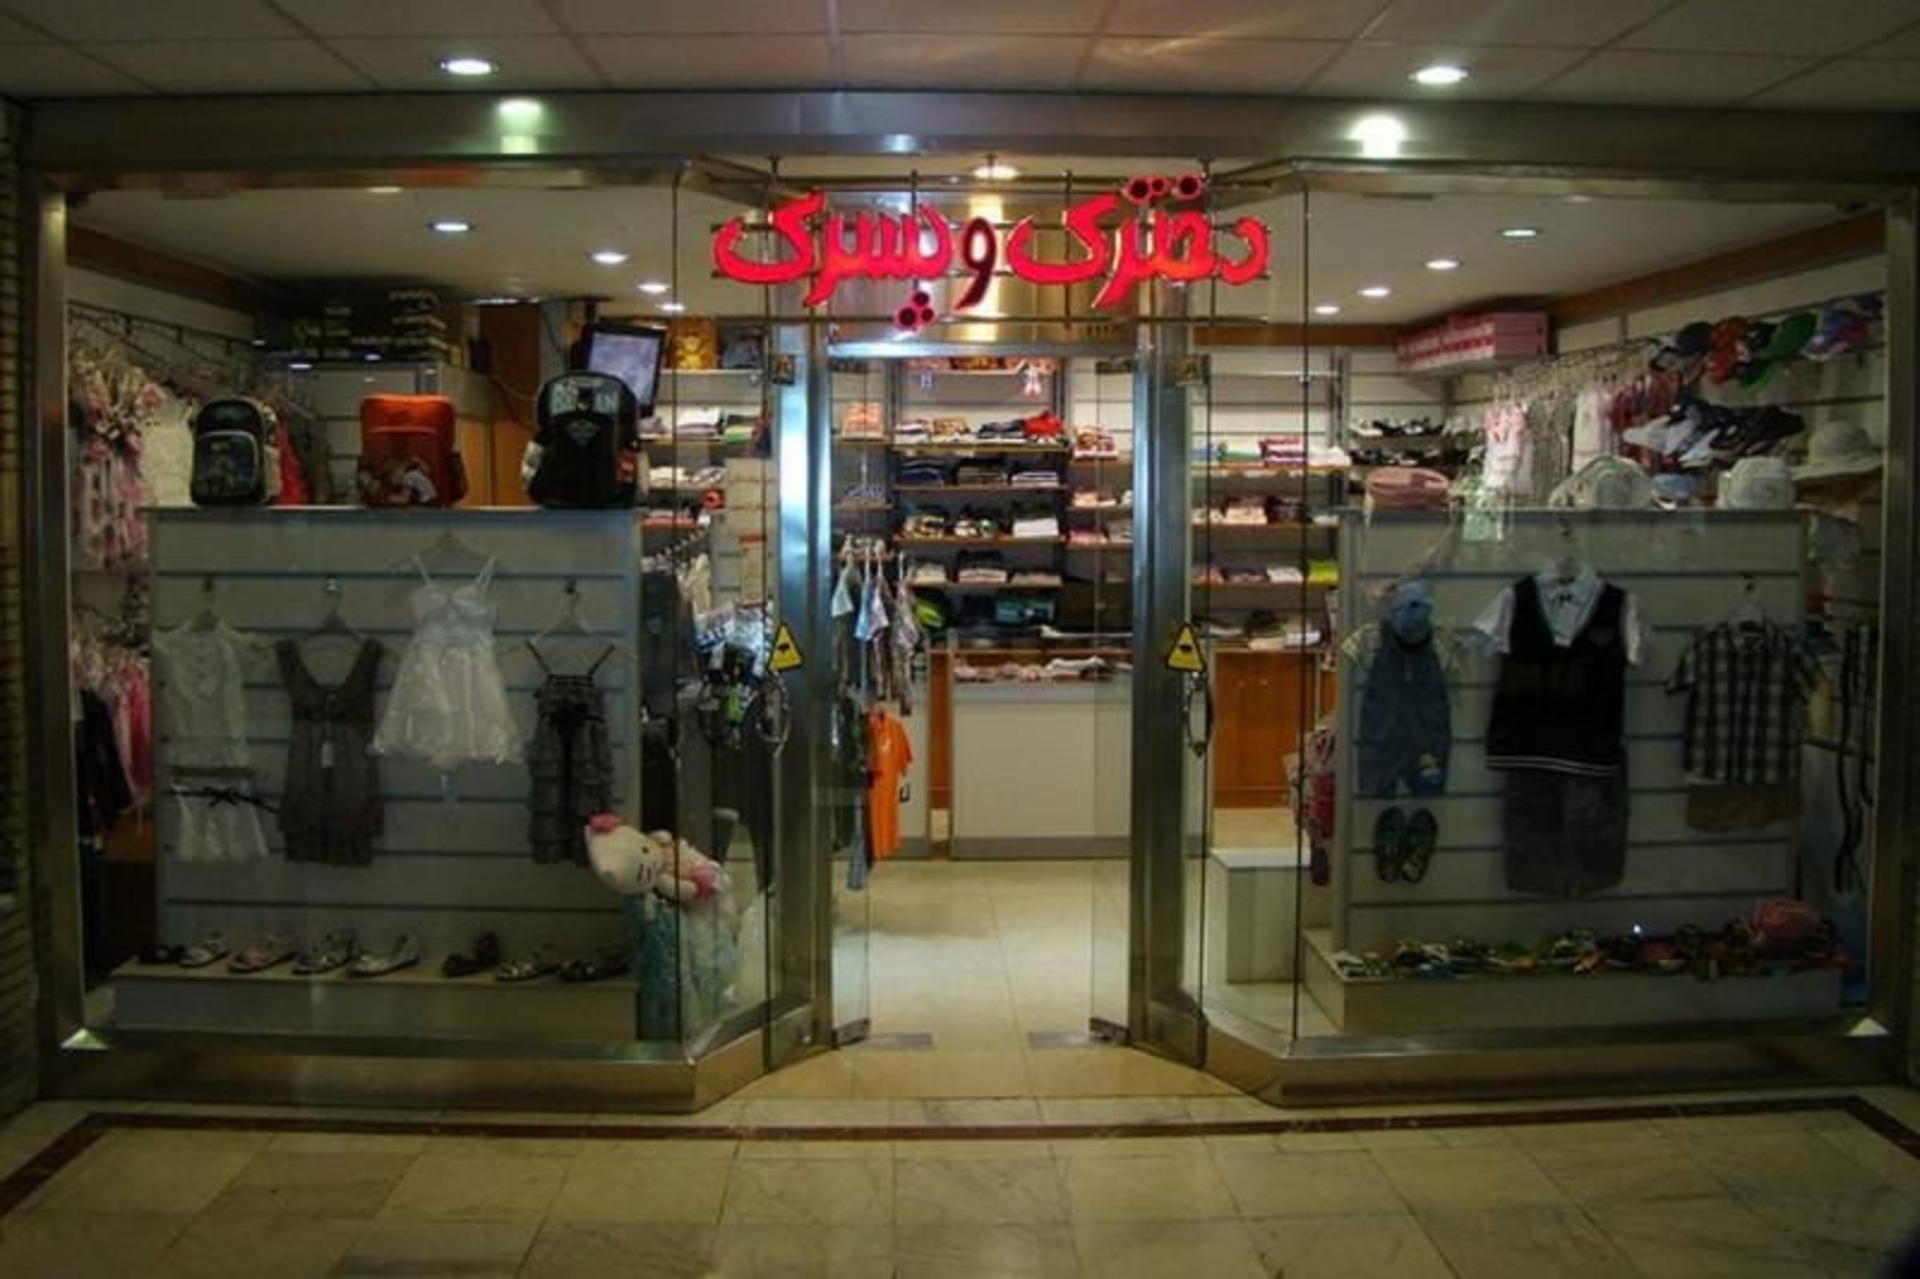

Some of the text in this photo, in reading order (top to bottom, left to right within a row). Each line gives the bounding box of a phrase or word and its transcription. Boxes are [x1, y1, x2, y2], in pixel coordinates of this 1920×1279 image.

[713, 174, 1269, 329] دخترک و پسرک
